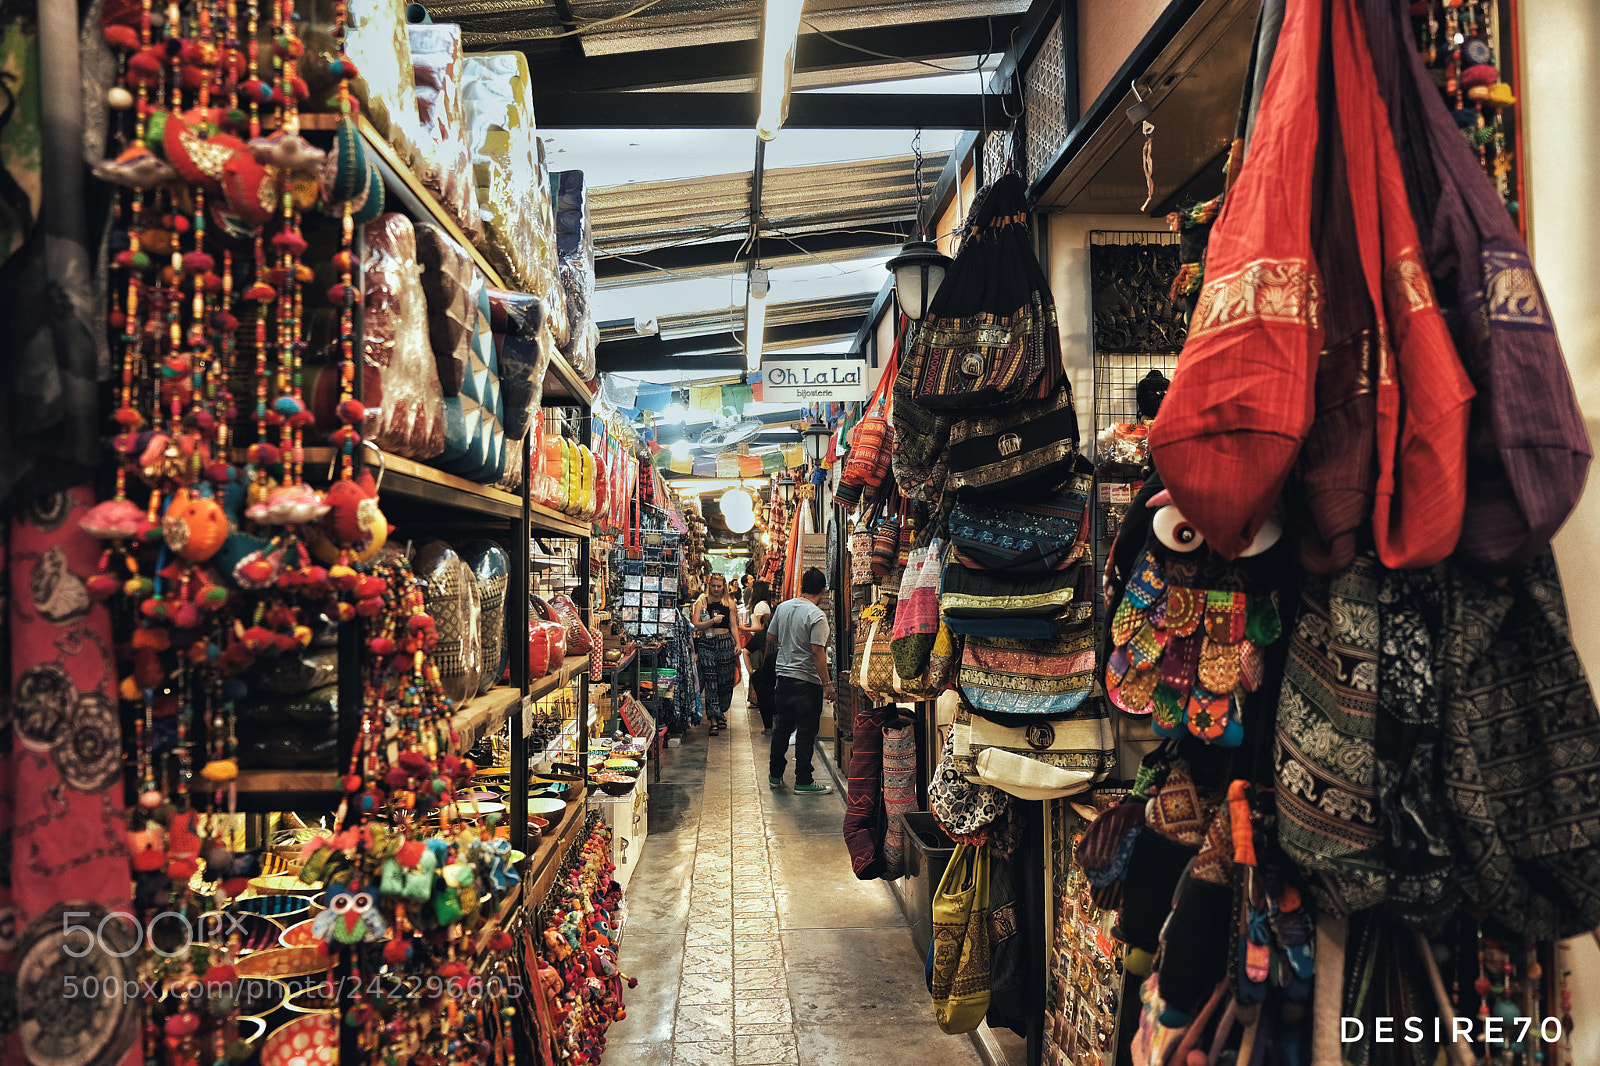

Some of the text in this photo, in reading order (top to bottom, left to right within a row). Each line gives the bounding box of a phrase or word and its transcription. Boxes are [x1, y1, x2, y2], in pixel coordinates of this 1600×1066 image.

[768, 366, 861, 385] Oh La La!
